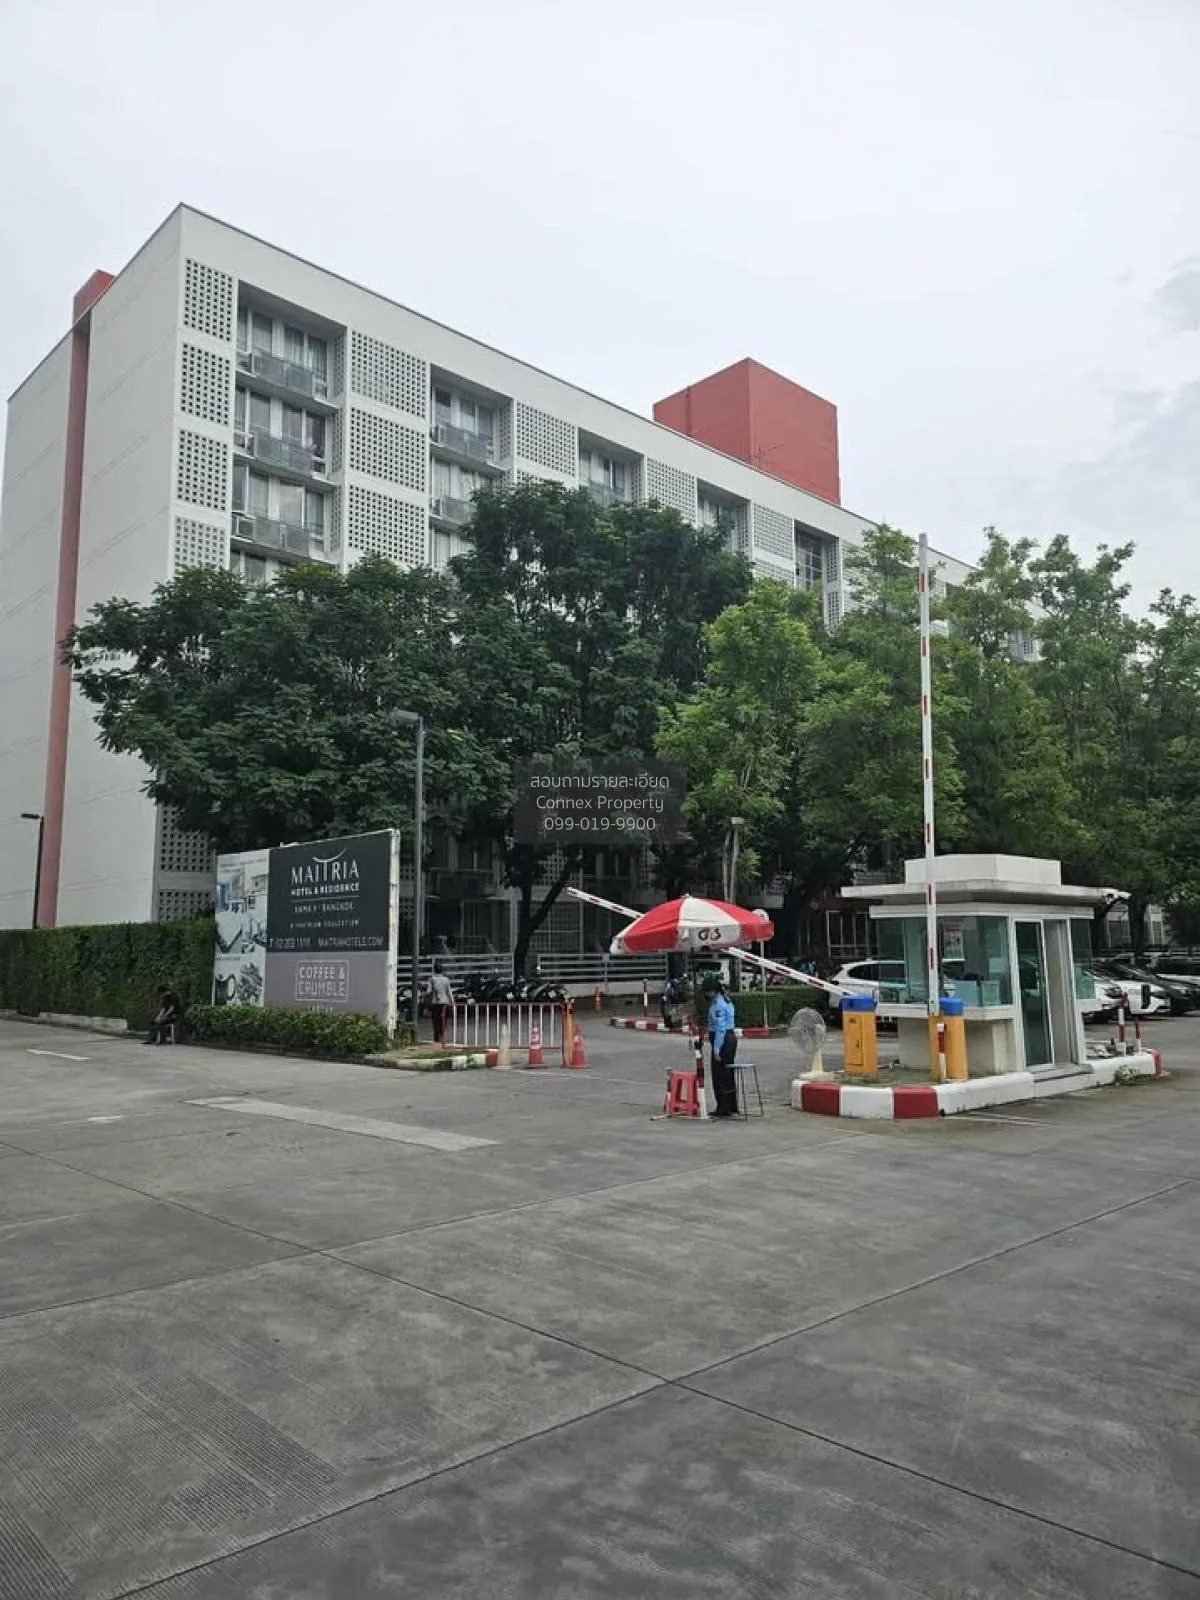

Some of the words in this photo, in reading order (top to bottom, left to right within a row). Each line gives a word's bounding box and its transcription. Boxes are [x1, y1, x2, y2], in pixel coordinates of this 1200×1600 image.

[291, 858, 360, 885] MAITRIA
[299, 966, 335, 980] COFFEE
[338, 966, 345, 980] &
[297, 980, 346, 997] CRUMBLE
